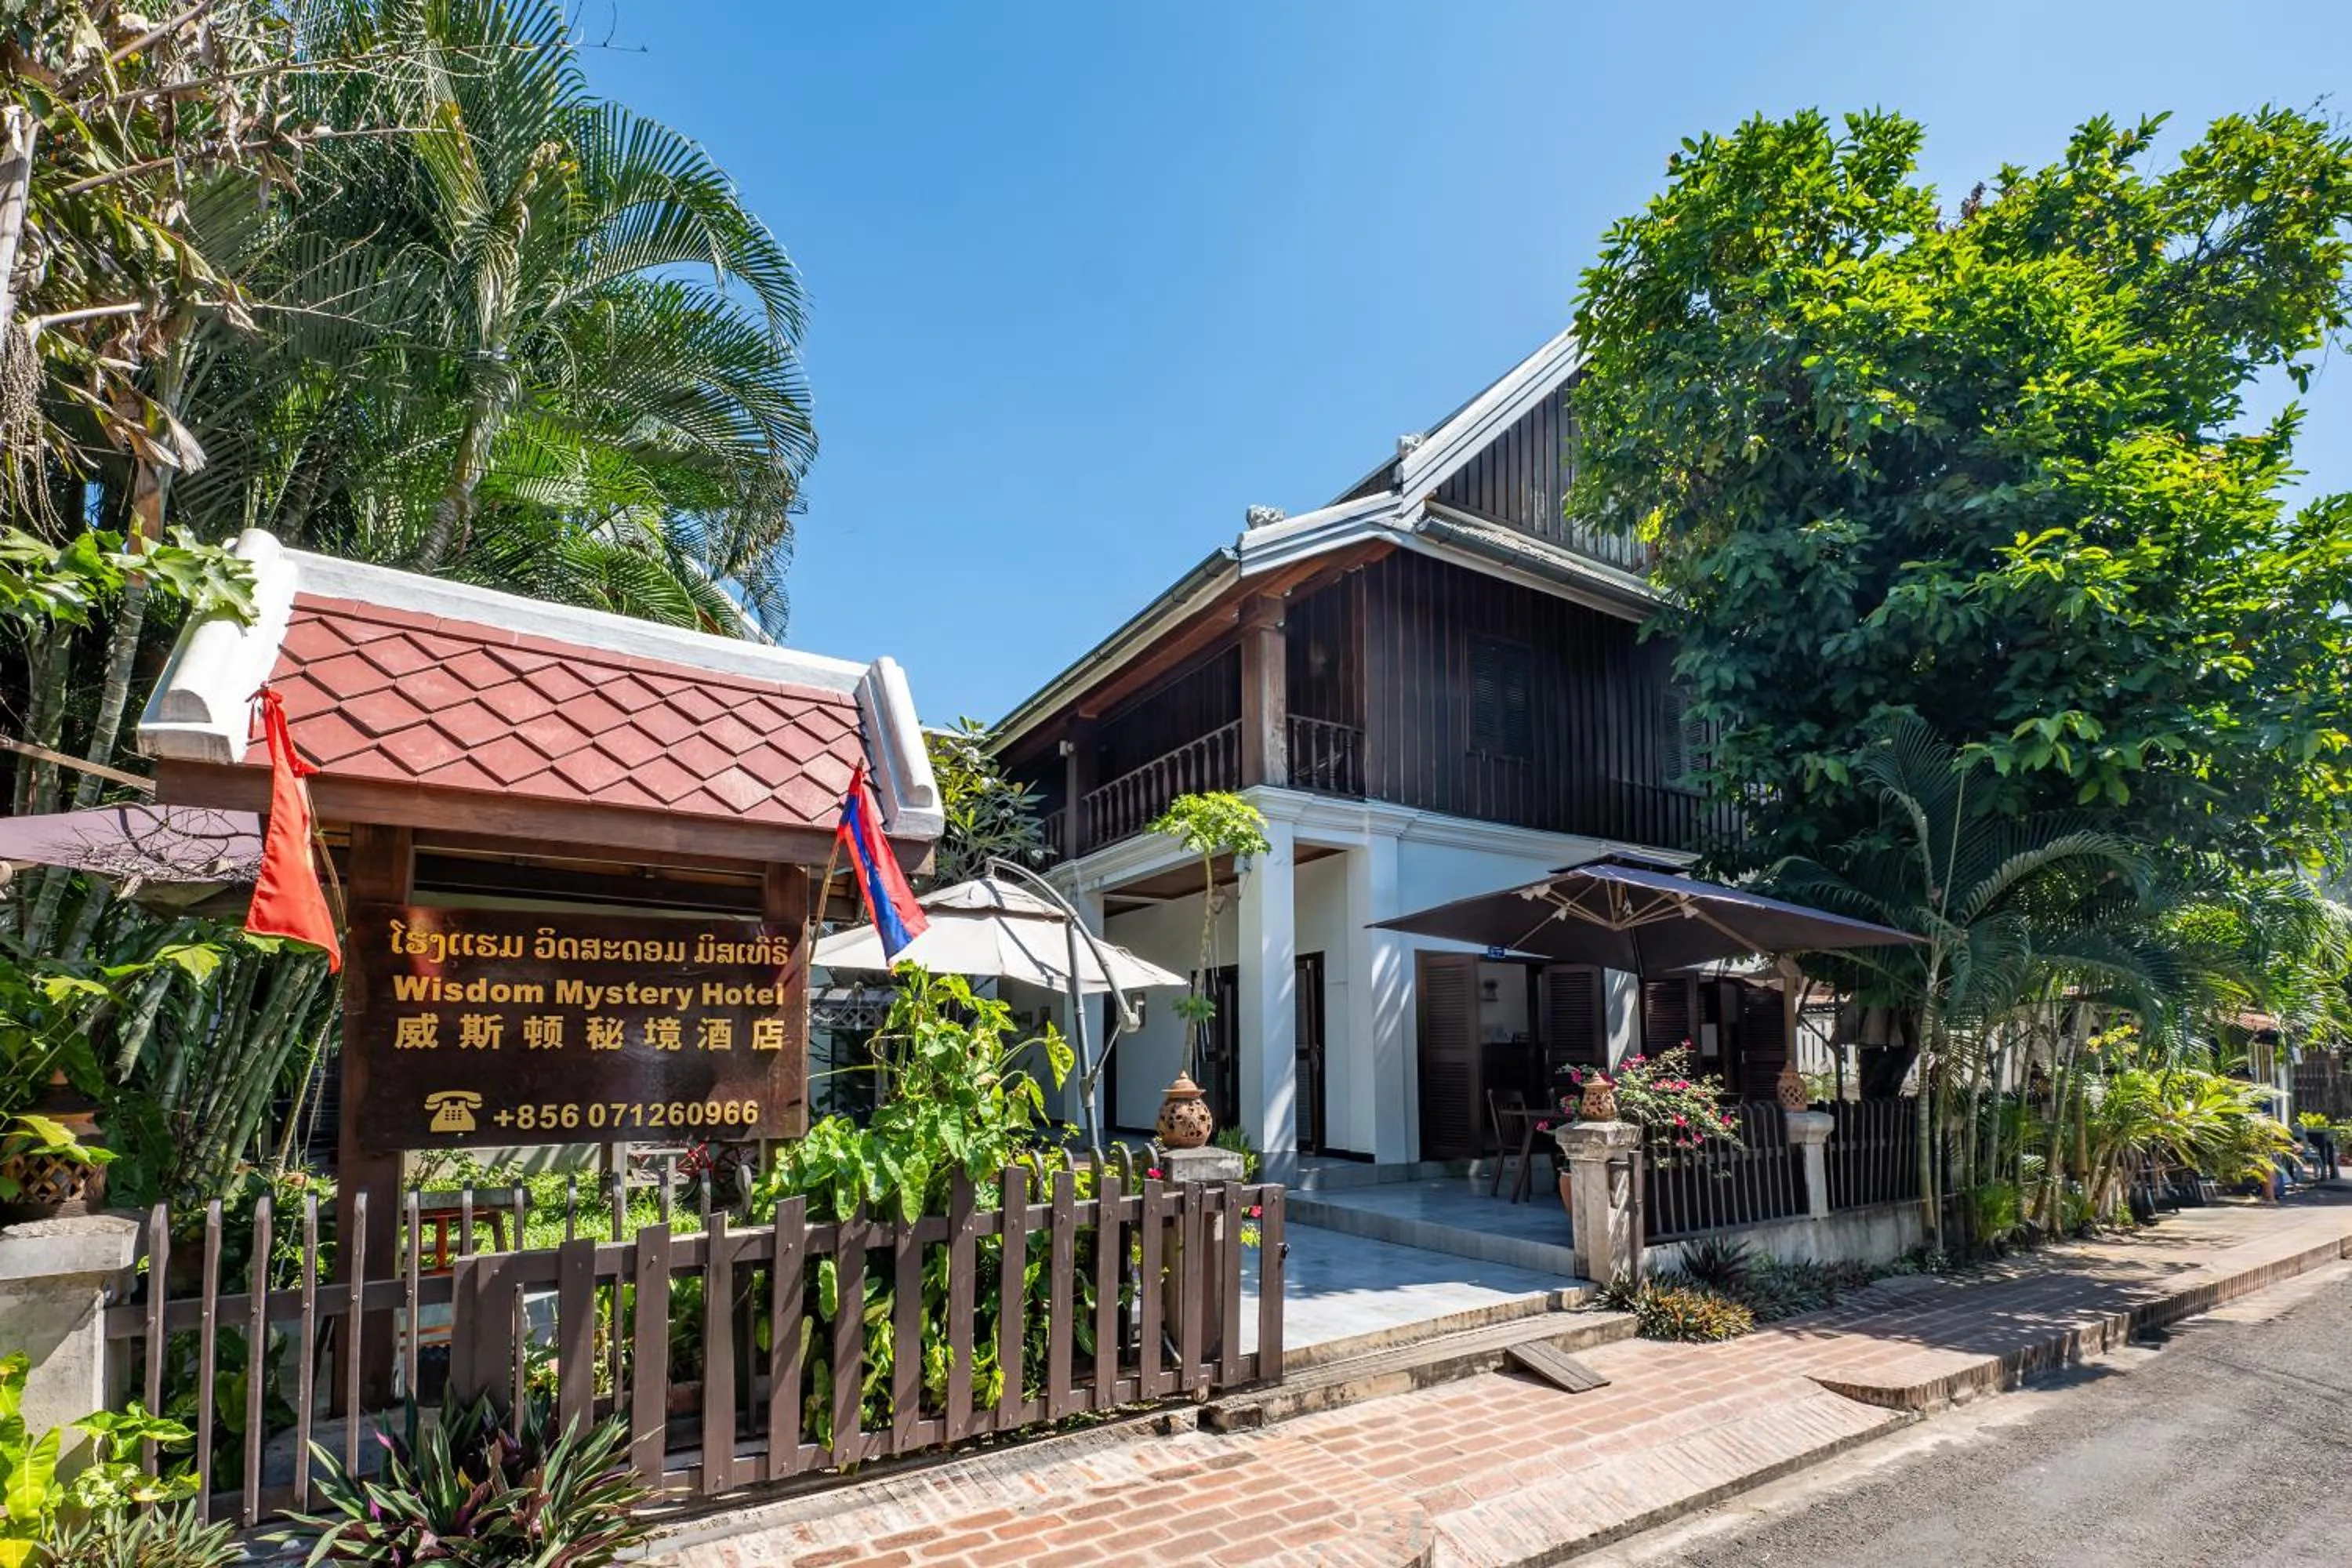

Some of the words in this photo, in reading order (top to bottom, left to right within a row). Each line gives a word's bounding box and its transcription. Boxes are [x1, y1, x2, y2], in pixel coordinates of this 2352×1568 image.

[393, 975, 544, 1004] Wisdom
[555, 979, 694, 1011] Mystery
[702, 982, 784, 1006] Hotel
[394, 1012, 785, 1051] 威斯顿秘境酒店
[493, 1103, 579, 1130] +856
[588, 1100, 759, 1128] 071260966
